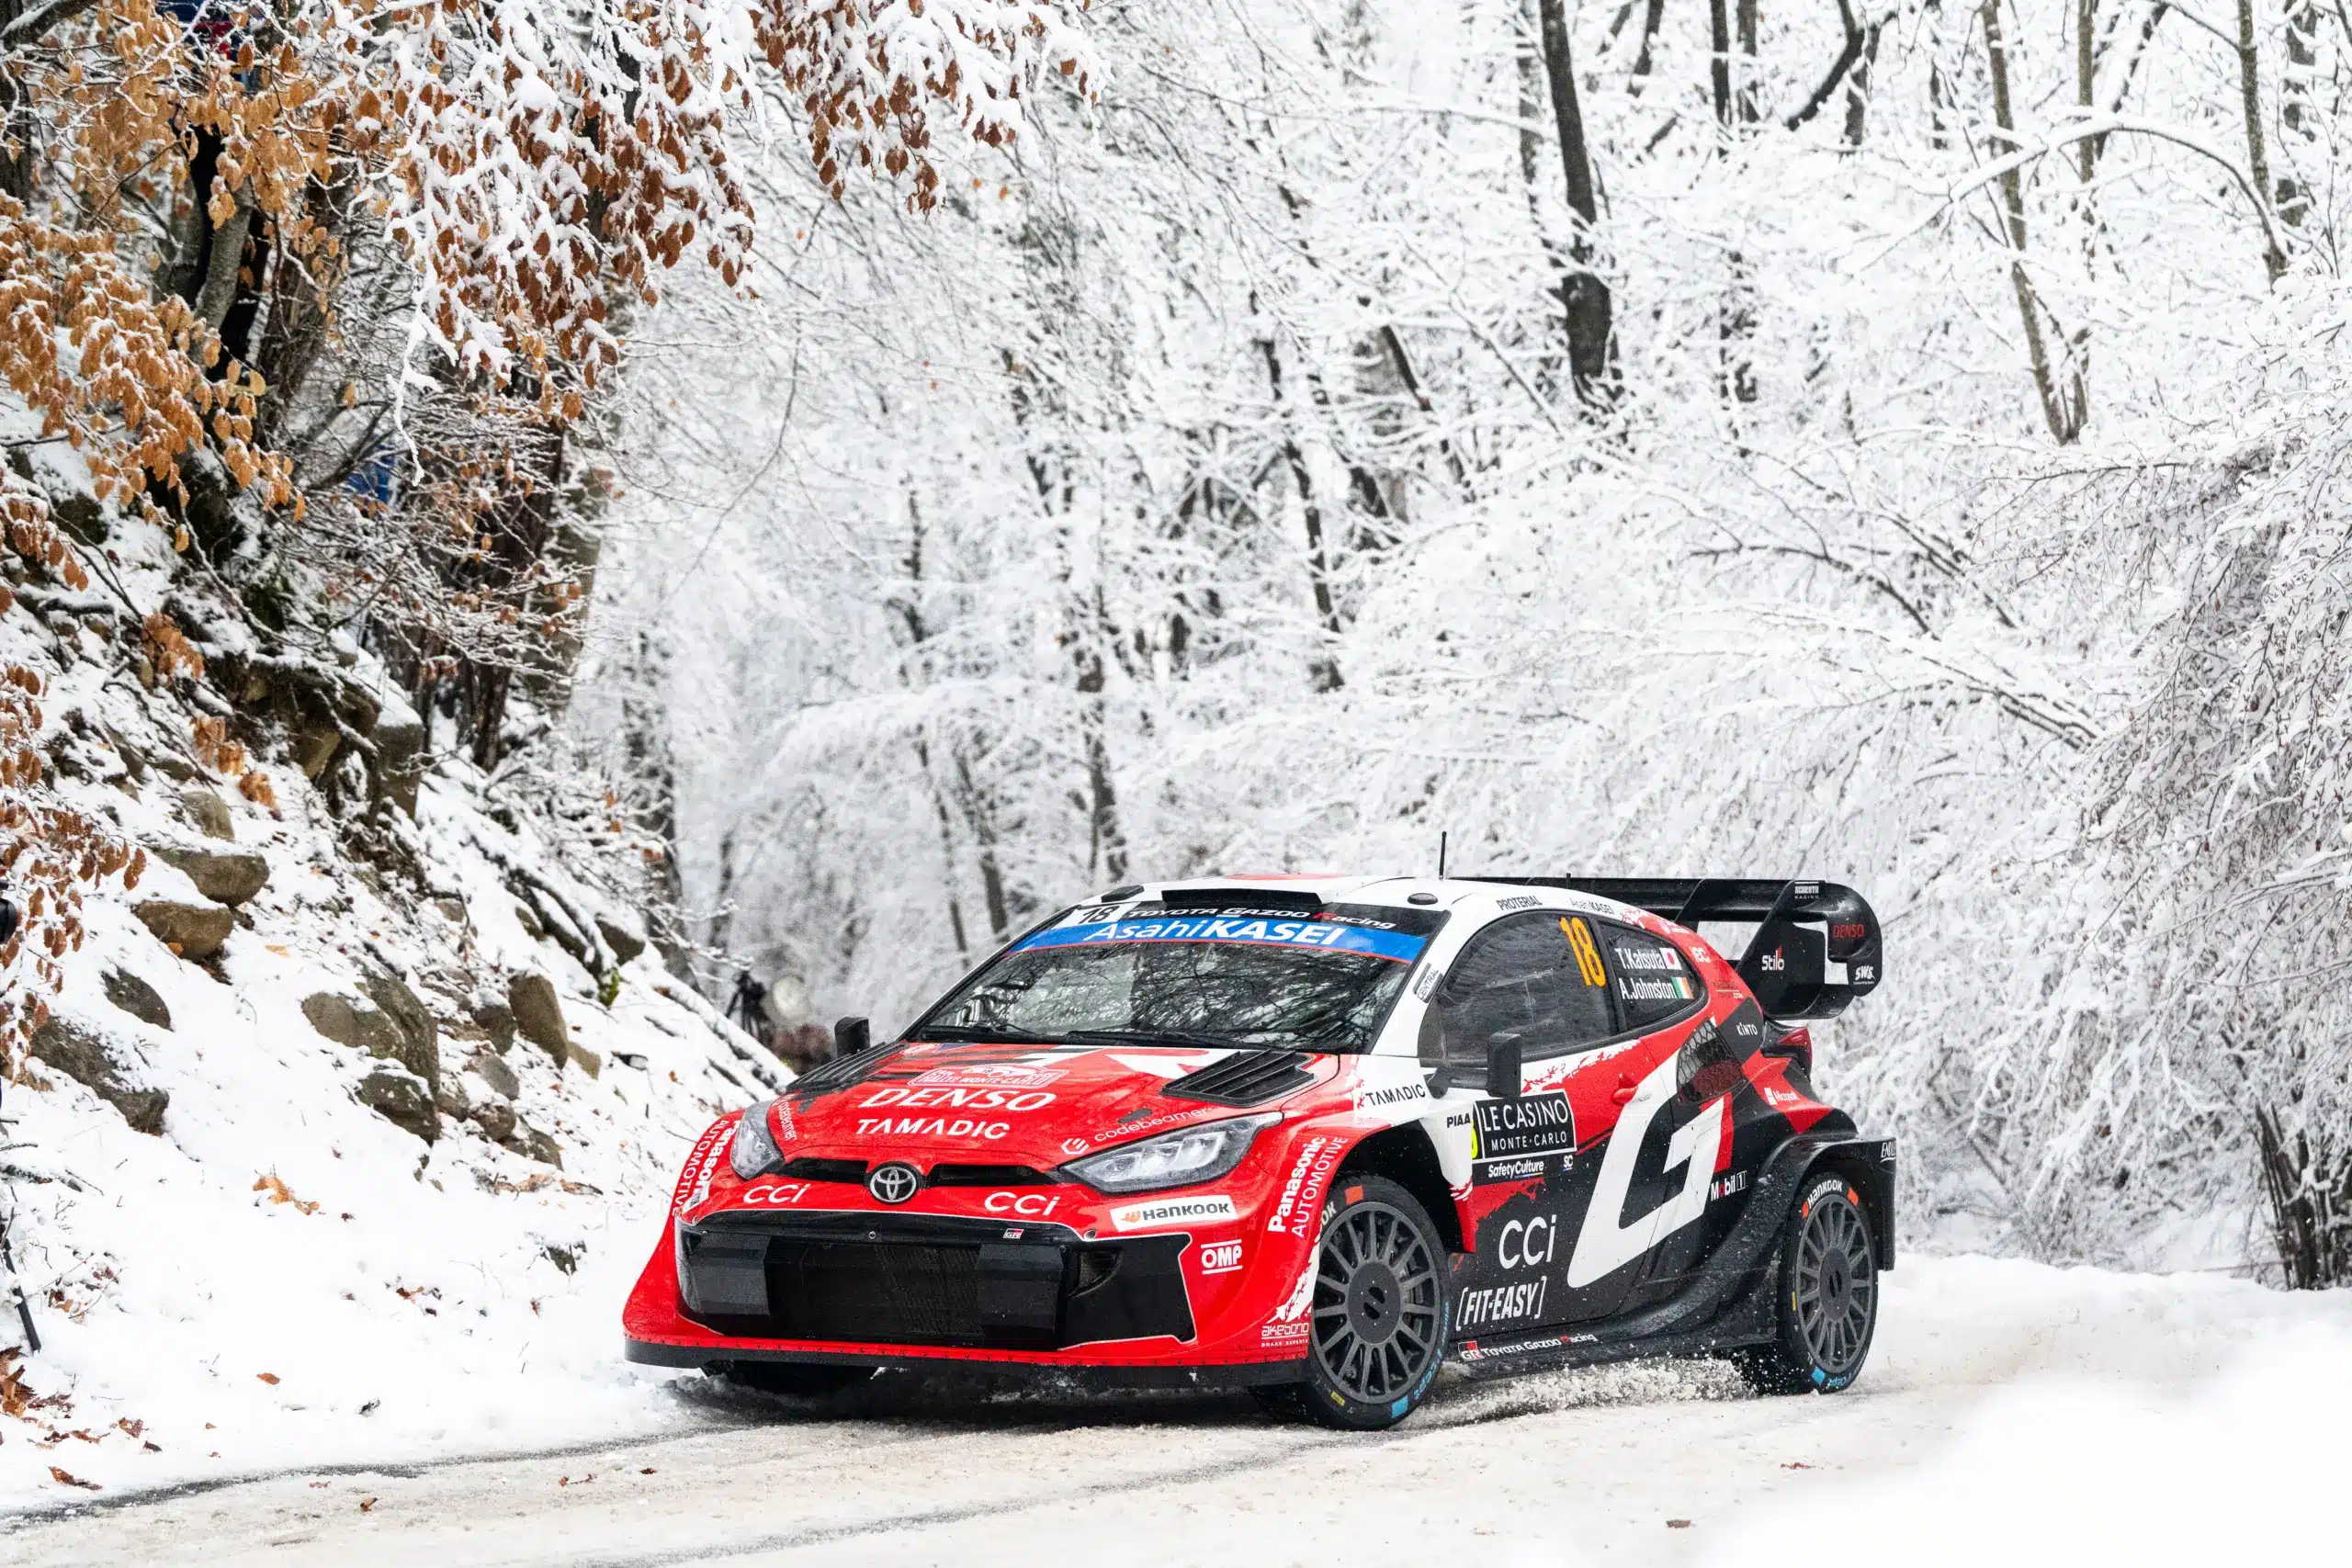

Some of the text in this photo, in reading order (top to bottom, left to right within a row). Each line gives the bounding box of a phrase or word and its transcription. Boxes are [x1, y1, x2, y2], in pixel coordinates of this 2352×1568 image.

[1496, 895, 1544, 911] PROTERIAL
[1078, 905, 1121, 925] 18
[1128, 907, 1396, 930] TOYOTA GAZOO Racing
[1832, 923, 1865, 939] DENSO
[1559, 917, 1607, 988] 18
[1761, 947, 1785, 971] Stilo
[1854, 964, 1876, 981] SWS
[1417, 969, 1440, 1000] CENTRAL
[857, 1088, 1057, 1111] DENSO
[1365, 1084, 1426, 1106] TAMADIC
[1773, 1090, 1801, 1102] Microsoft
[1093, 1108, 1209, 1143] codebeamer
[1446, 1111, 1471, 1129] PIAA
[1481, 1099, 1568, 1133] LE CASINO
[855, 1118, 1011, 1139] TAMADIC
[1487, 1159, 1544, 1179] SafetyCulture
[1563, 1155, 1574, 1168] SC
[743, 1183, 811, 1204] CCi
[1267, 1136, 1327, 1233] Panasonic
[1291, 1136, 1349, 1238] AUTOMOTIVE
[1711, 1176, 1736, 1201] Mobil
[984, 1191, 1061, 1216] CCi
[1498, 1214, 1557, 1269] CCi
[1201, 1245, 1242, 1269] OMP
[1261, 1323, 1309, 1337] akebono
[1481, 1345, 1525, 1357] TOYOTA
[1523, 1337, 1562, 1350] GAZOO
[1560, 1333, 1598, 1344] Racing
